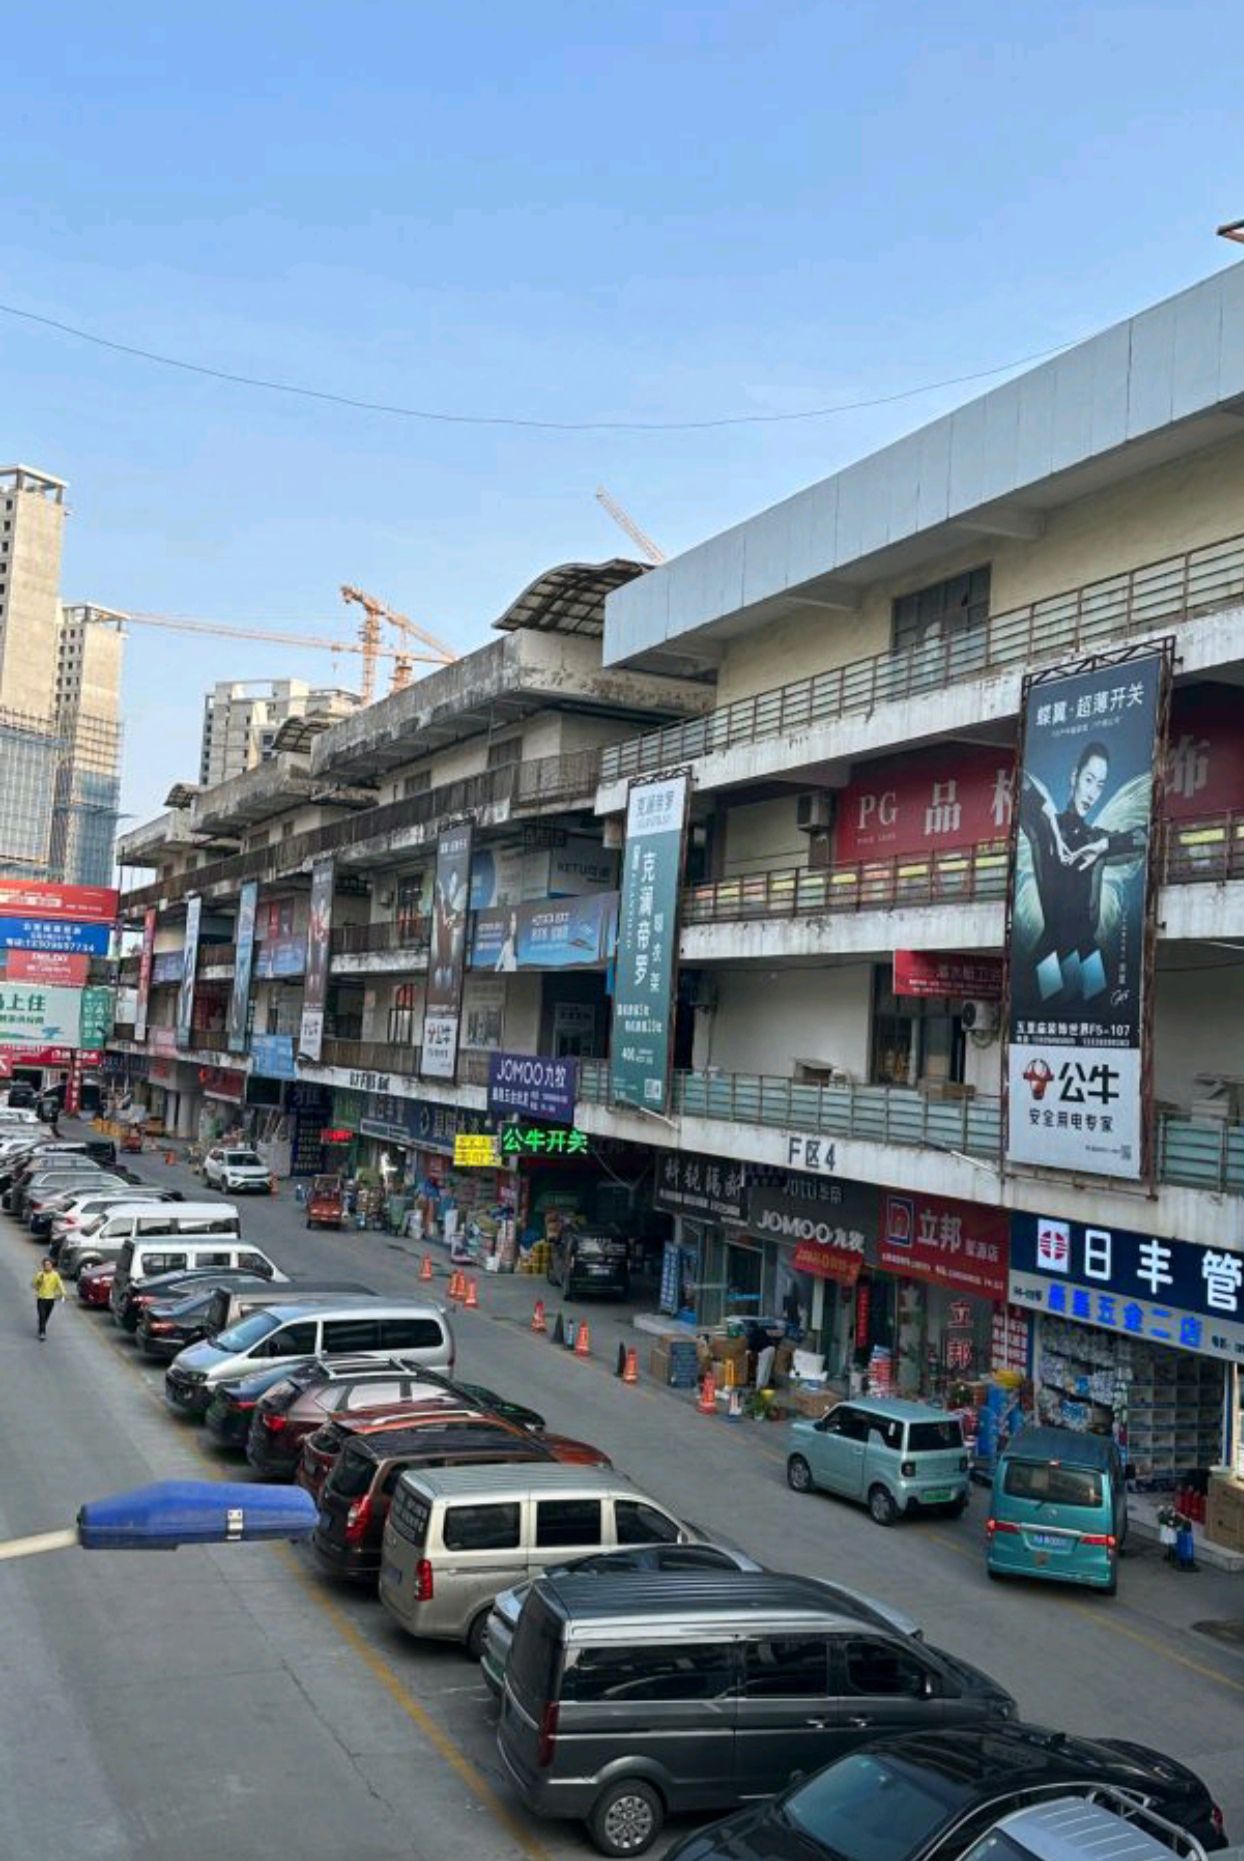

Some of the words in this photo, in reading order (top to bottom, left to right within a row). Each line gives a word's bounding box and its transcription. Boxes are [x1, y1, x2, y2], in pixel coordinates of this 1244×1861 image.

[858, 791, 899, 830] PG
[1058, 1062, 1119, 1105] 公牛
[1028, 1108, 1113, 1132] 安全用电专家
[503, 1127, 588, 1155] 公牛开关
[788, 1136, 837, 1171] F区4
[917, 1208, 963, 1254] 立邦
[1084, 1227, 1244, 1312] 日丰管
